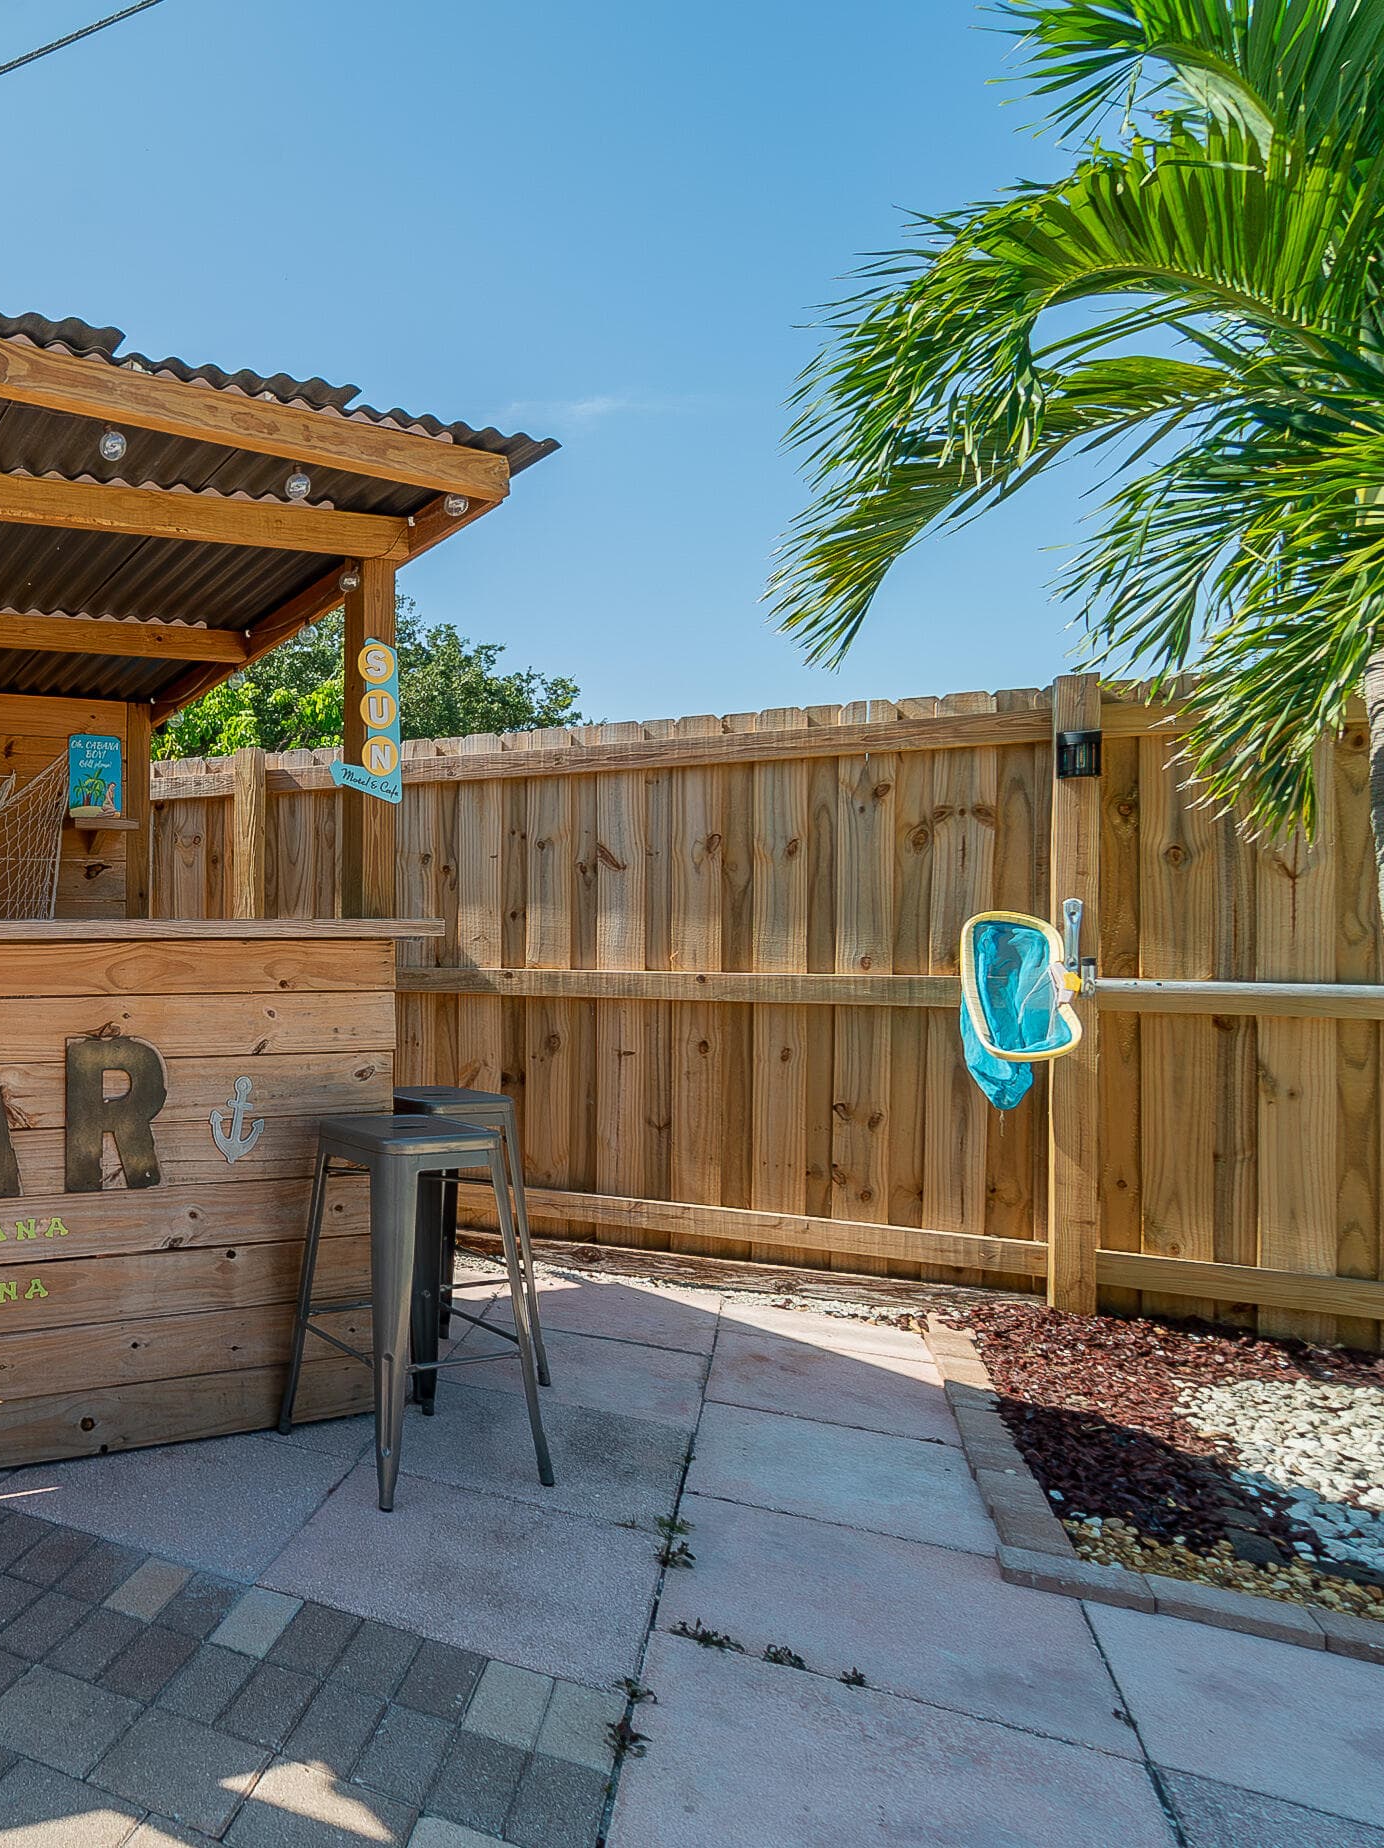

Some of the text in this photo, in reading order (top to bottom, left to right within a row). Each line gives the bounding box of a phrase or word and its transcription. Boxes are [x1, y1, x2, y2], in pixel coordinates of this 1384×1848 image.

[85, 741, 119, 751] CABANA
[341, 768, 371, 786] Motel
[370, 780, 378, 790] &
